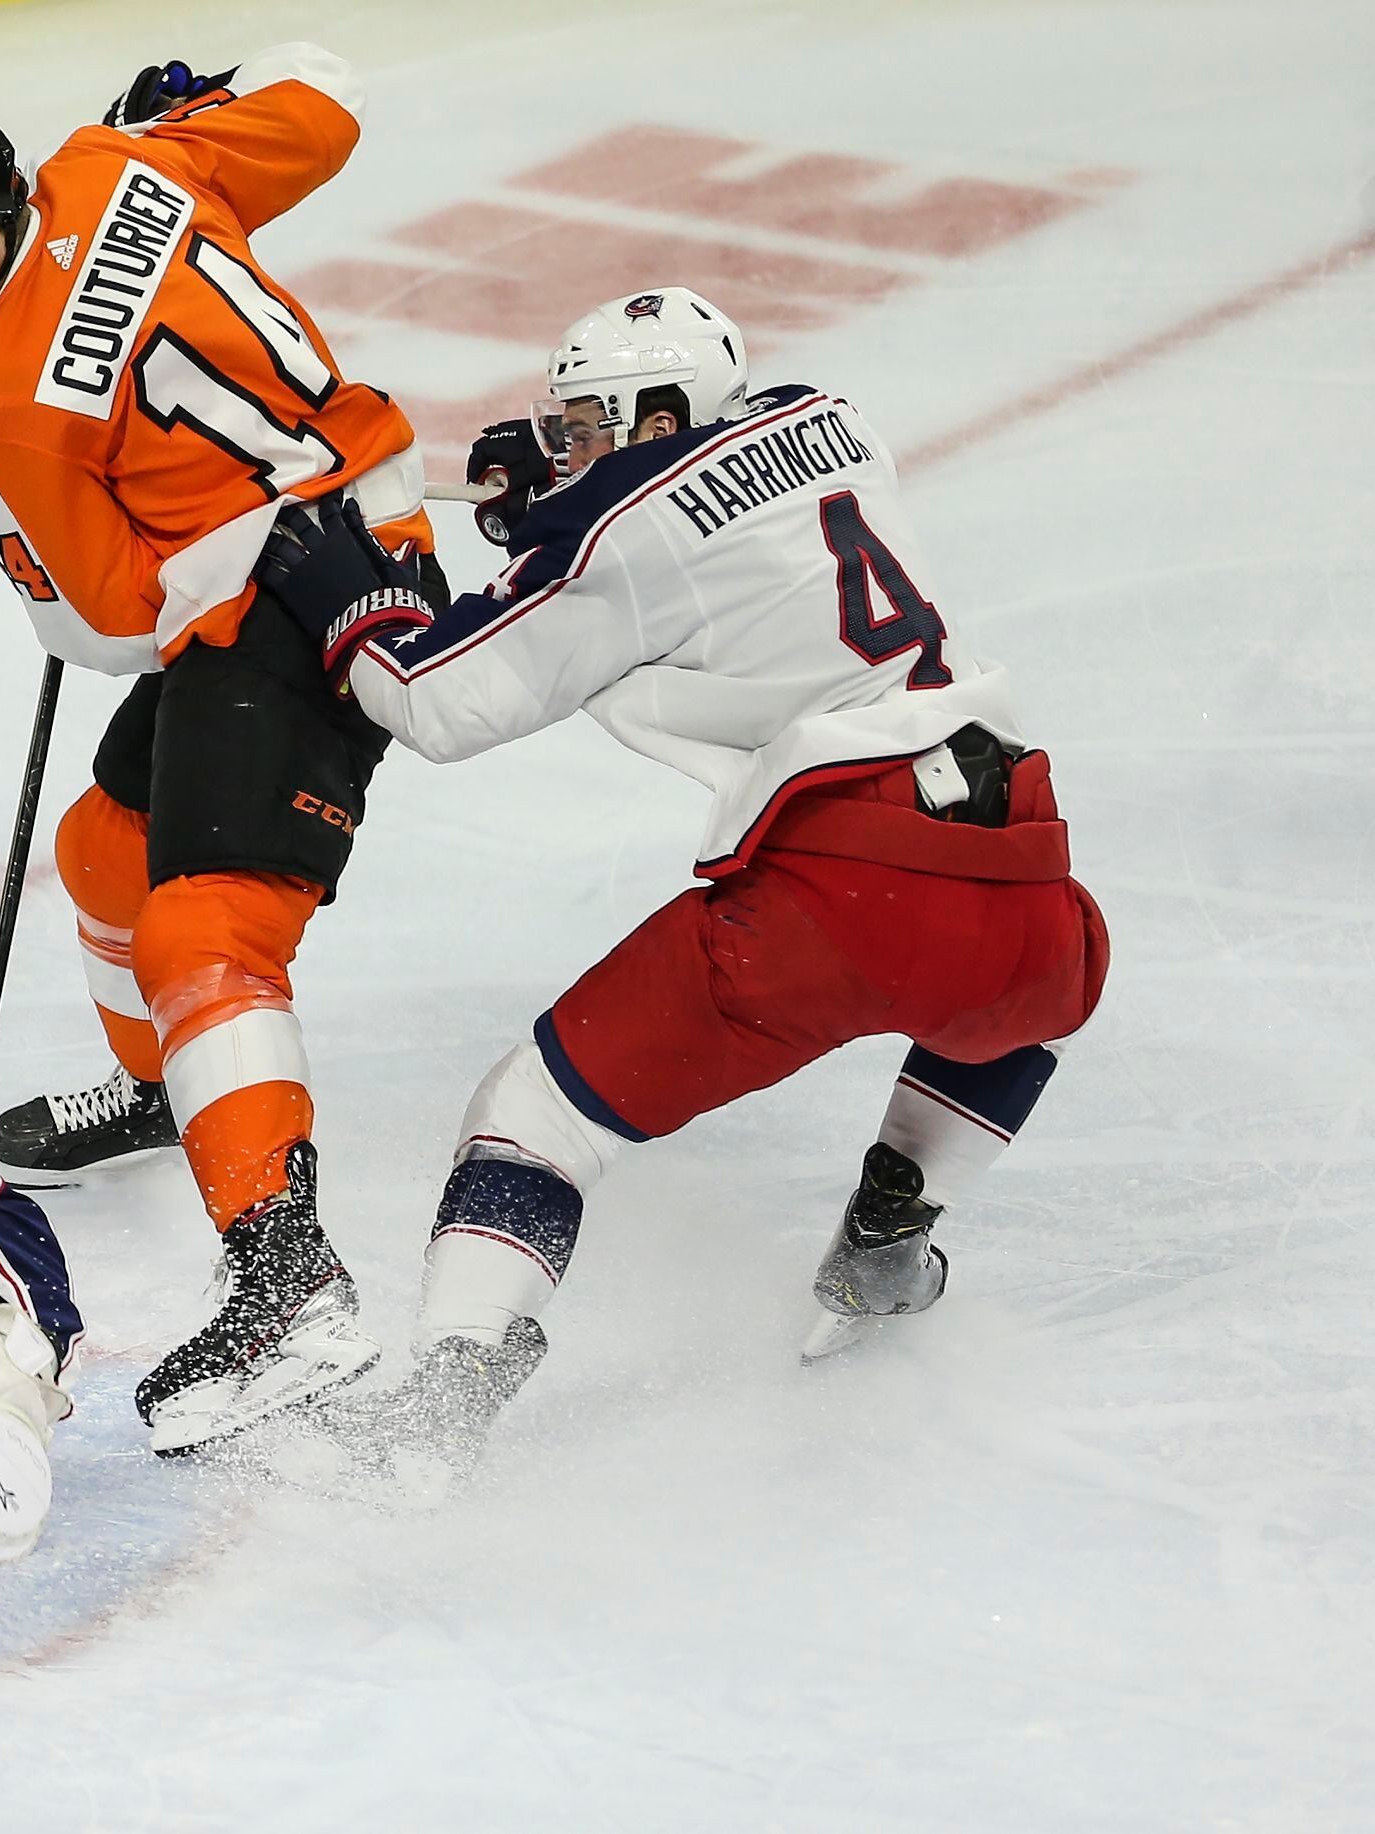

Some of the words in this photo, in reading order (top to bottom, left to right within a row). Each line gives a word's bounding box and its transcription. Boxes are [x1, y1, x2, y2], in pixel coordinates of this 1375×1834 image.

[52, 173, 186, 397] COUTURIER
[61, 233, 80, 271] adidas
[130, 229, 347, 502] 14
[326, 586, 436, 651] ARRIOR
[819, 489, 955, 691] 4
